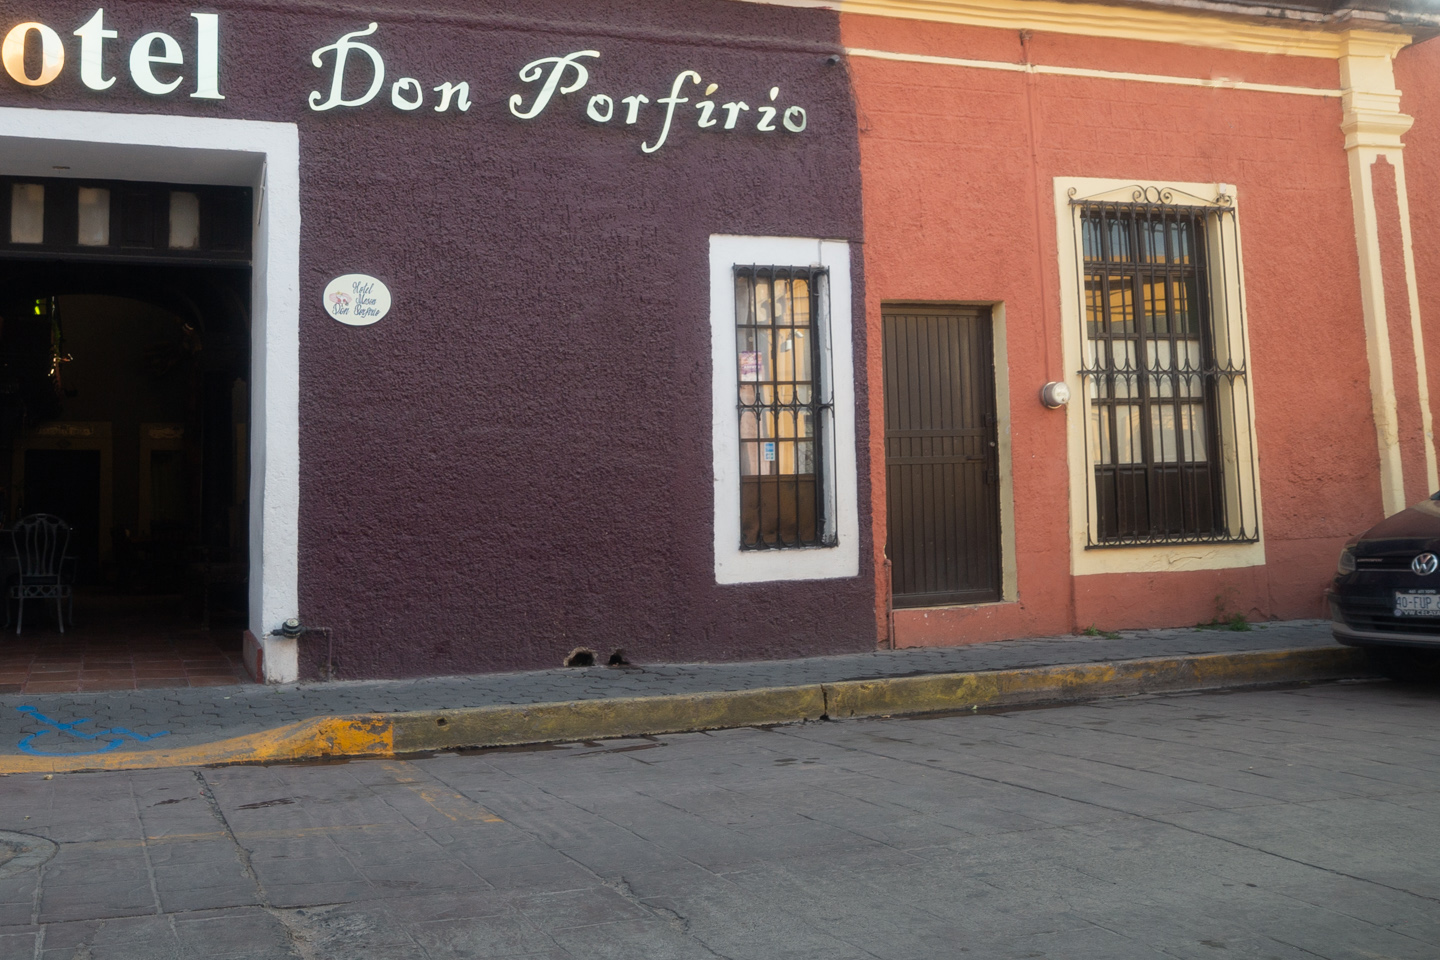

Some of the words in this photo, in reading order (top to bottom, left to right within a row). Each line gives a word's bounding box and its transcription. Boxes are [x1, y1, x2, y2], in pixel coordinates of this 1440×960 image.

[309, 22, 471, 112] Don
[510, 50, 806, 153] Porfirio
[352, 281, 374, 294] Hotel
[332, 303, 349, 315] Don
[354, 304, 380, 318] Porfirio
